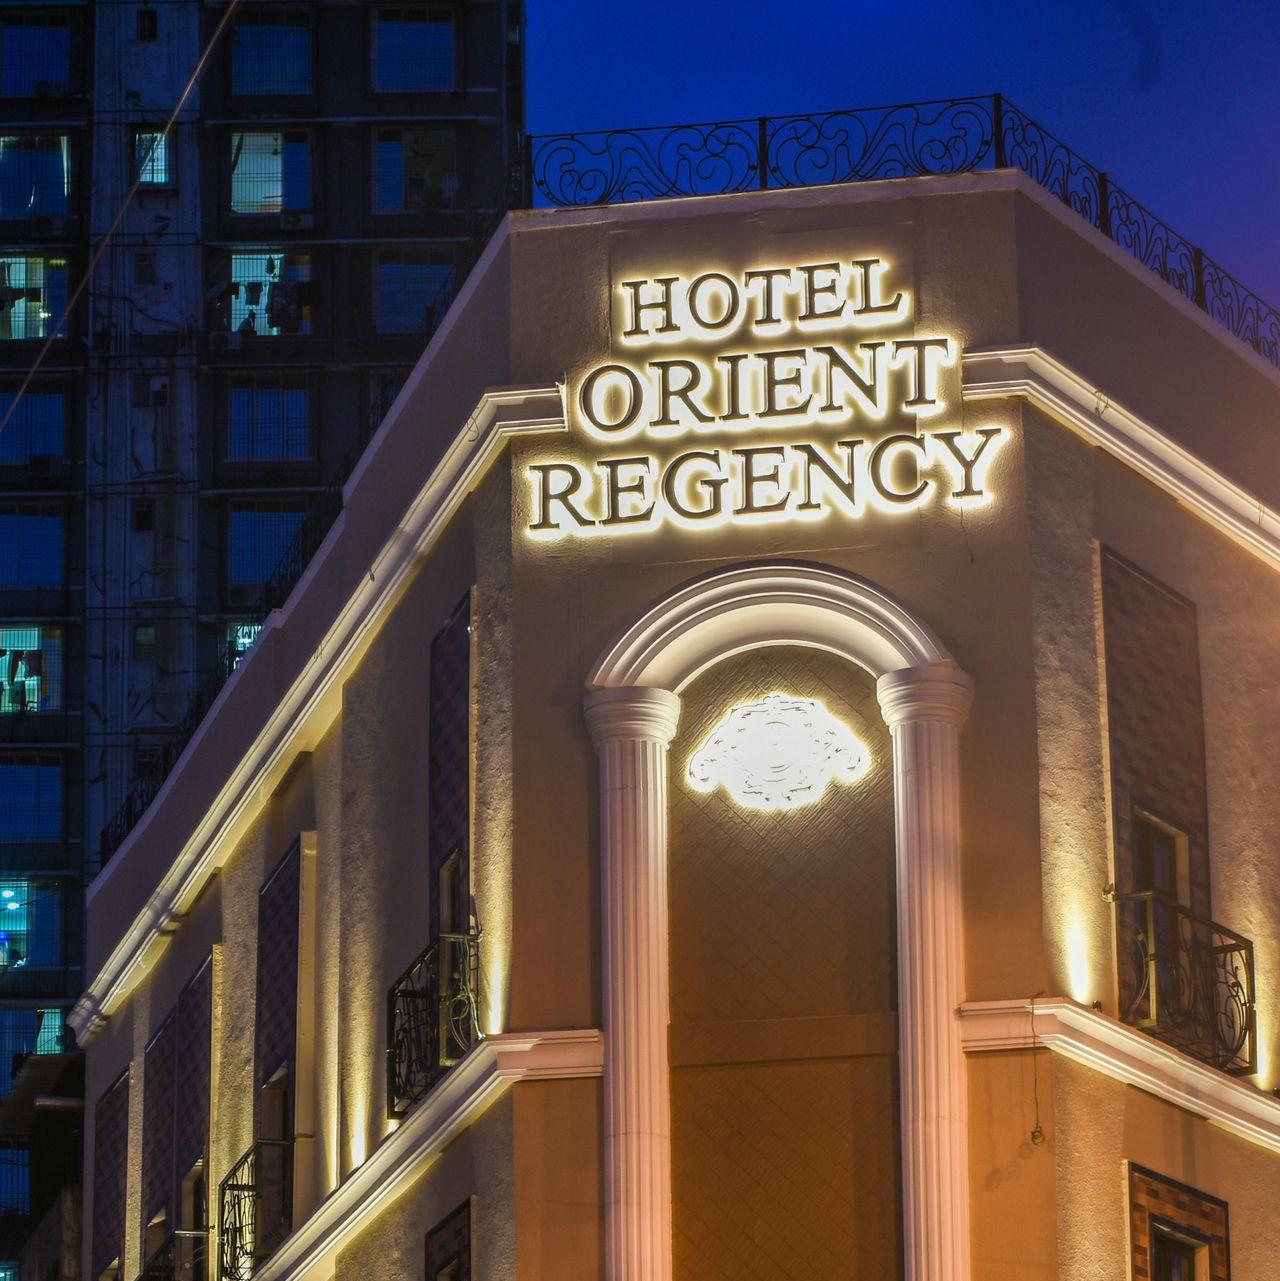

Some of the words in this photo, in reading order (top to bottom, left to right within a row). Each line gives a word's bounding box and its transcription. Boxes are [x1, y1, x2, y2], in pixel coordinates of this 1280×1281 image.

[622, 258, 903, 339] HOTEL
[578, 337, 955, 433] ORIENT
[528, 427, 1002, 531] REGENCY
